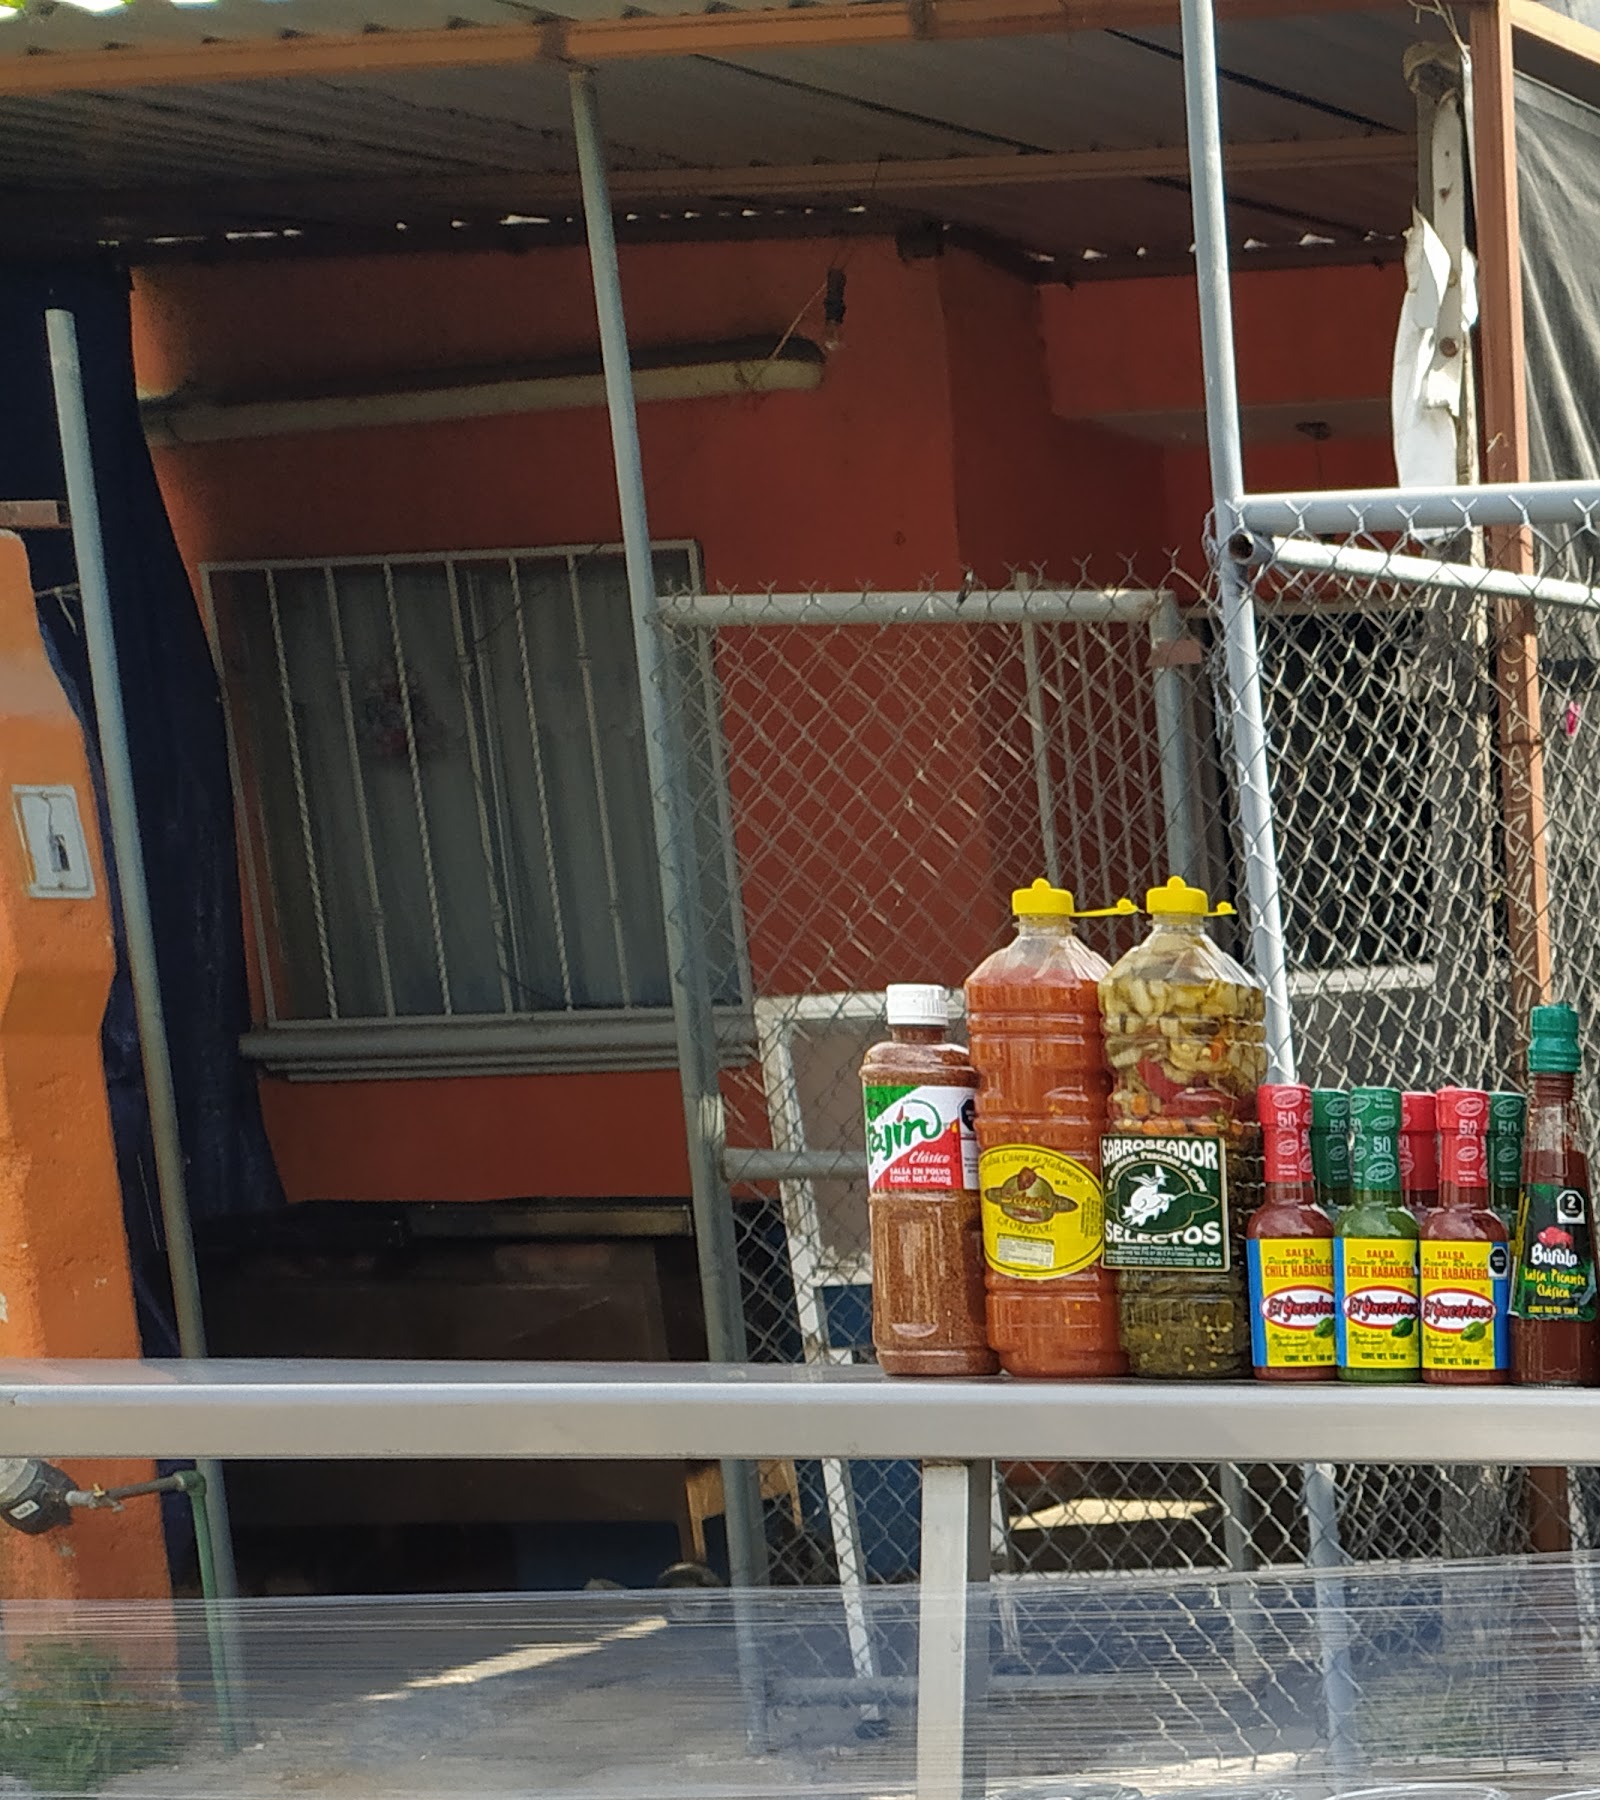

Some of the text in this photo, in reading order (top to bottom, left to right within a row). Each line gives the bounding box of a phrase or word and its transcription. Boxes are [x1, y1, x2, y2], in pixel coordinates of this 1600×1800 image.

[1277, 1111, 1297, 1128] 50
[1459, 1119, 1478, 1135] 50
[1373, 1136, 1392, 1152] 50
[909, 1151, 950, 1164] Clásico
[1102, 1139, 1218, 1170] SABROSEADOR
[1567, 1196, 1576, 1209] 2
[1105, 1219, 1221, 1245] SELECTOS
[1286, 1248, 1315, 1257] SALSA
[1366, 1250, 1394, 1258] SALSA
[1437, 1251, 1464, 1259] SALSA
[1531, 1242, 1578, 1267] Búfalo
[1265, 1265, 1288, 1277] CHILE
[1347, 1266, 1368, 1277] CHILE
[1442, 1267, 1488, 1279] HABANERO
[1524, 1268, 1586, 1286] Salsa Picante
[1537, 1284, 1570, 1299] Clásica
